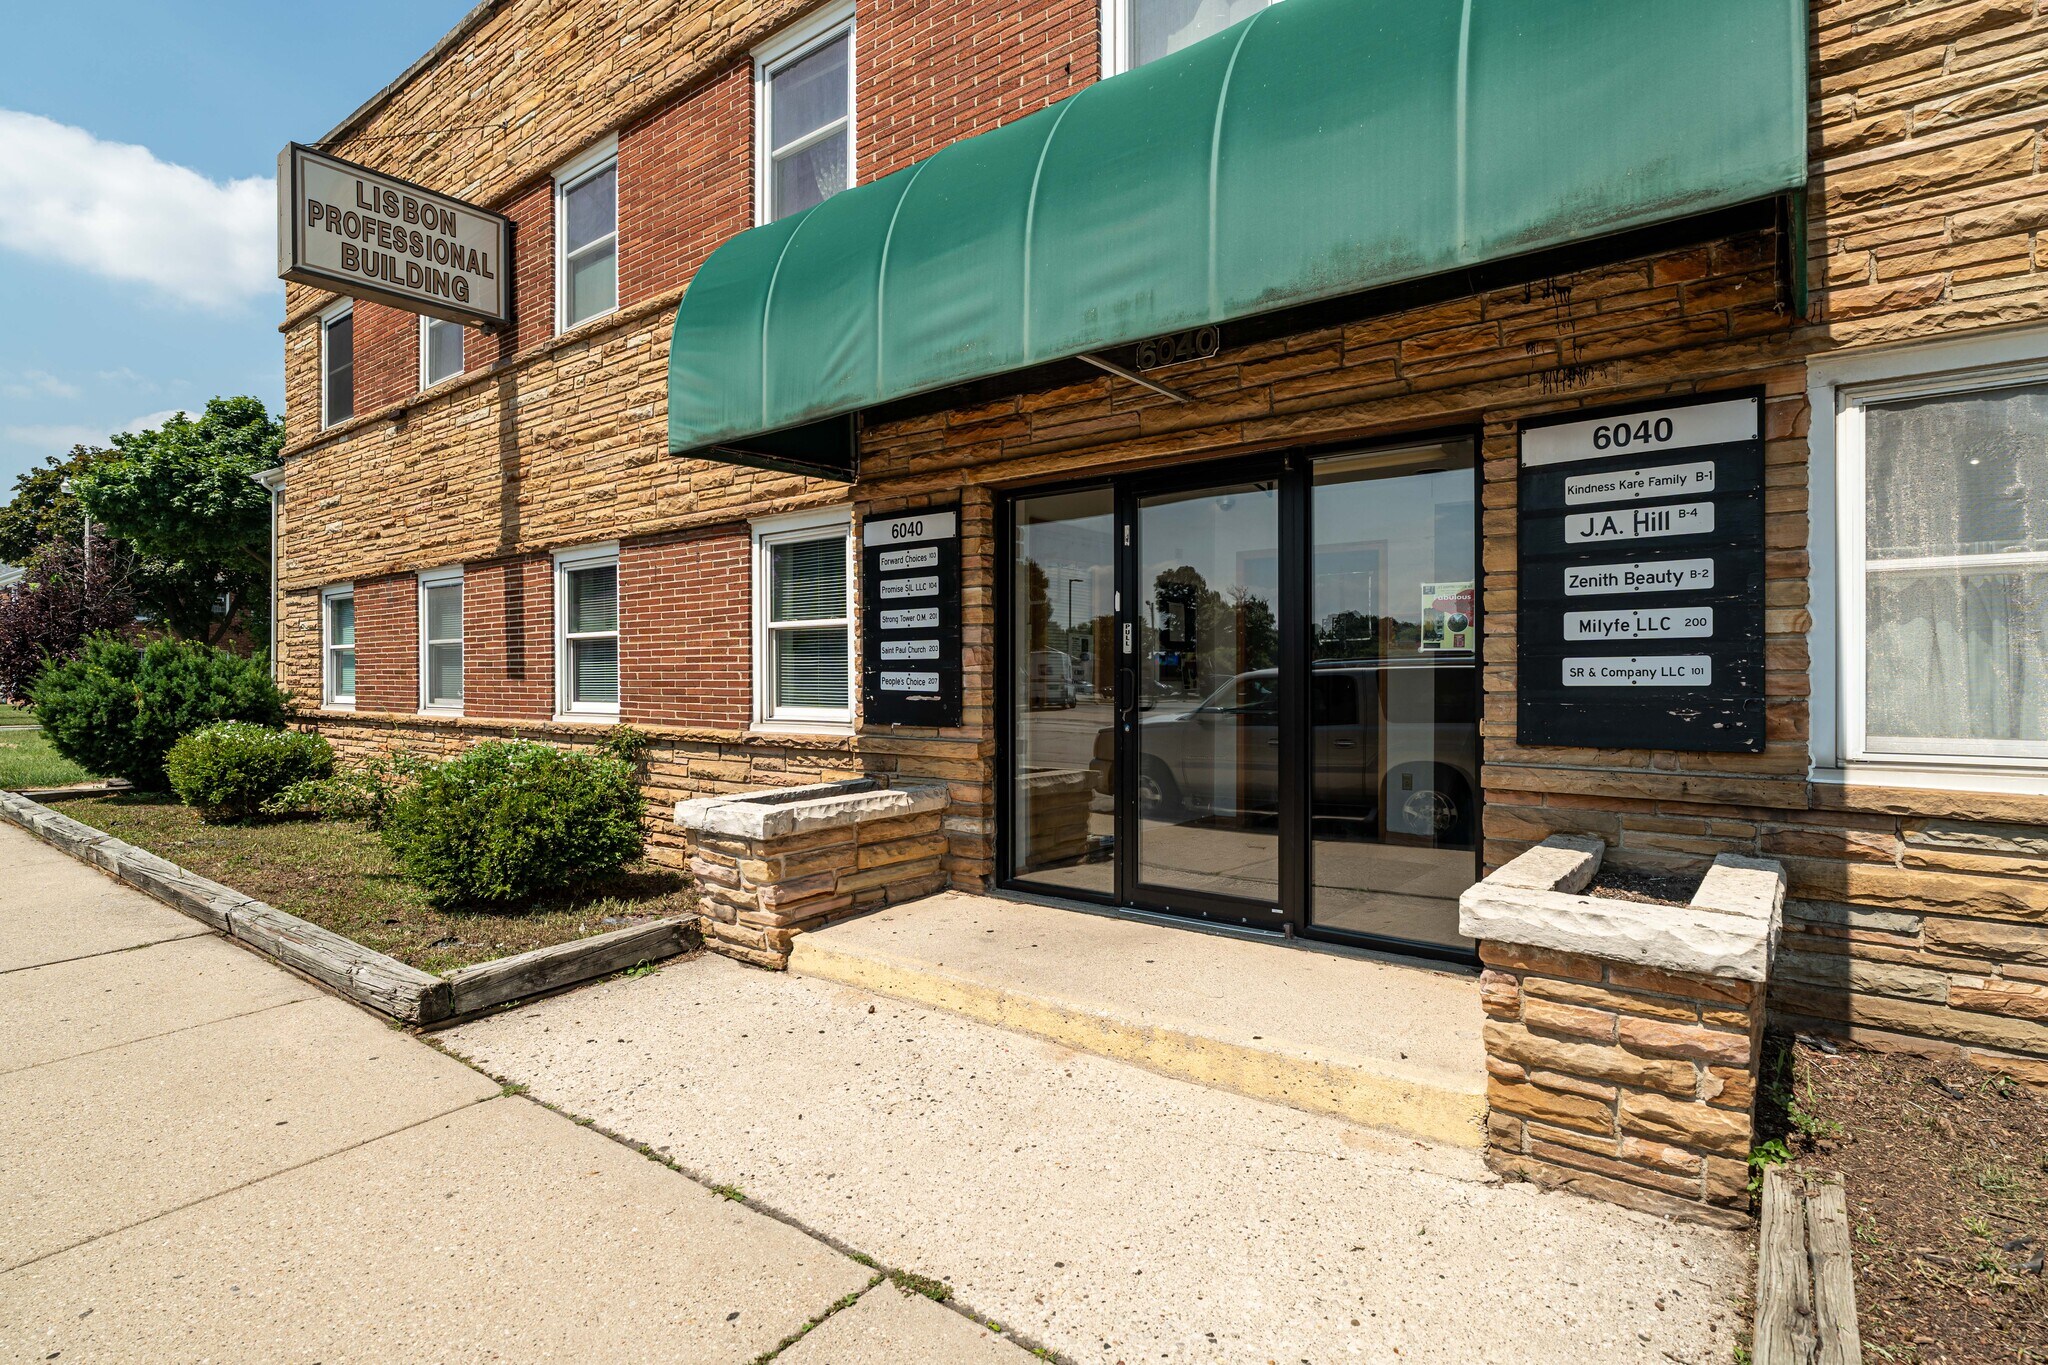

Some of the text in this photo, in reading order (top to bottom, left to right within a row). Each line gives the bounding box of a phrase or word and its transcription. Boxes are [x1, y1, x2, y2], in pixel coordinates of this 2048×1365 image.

[356, 180, 456, 238] LISBON
[308, 199, 494, 279] PROFESSIONAL
[342, 242, 469, 303] BUILDING
[1138, 327, 1217, 369] 6040
[1592, 417, 1674, 451] 6040
[1567, 470, 1712, 495] Kindness Kare Family B-1
[892, 521, 923, 538] 6040
[1580, 508, 1698, 537] J.A. Hill B-4
[881, 556, 903, 565] Forward
[905, 554, 927, 563] Choices
[916, 583, 927, 591] LLC
[1569, 569, 1709, 589] Zenith Beauty B-2
[1579, 617, 1707, 637] Milyfe LLC 200
[882, 677, 904, 686] People's
[906, 678, 925, 686] Choice
[1569, 667, 1704, 680] SR & Company LLC 101
